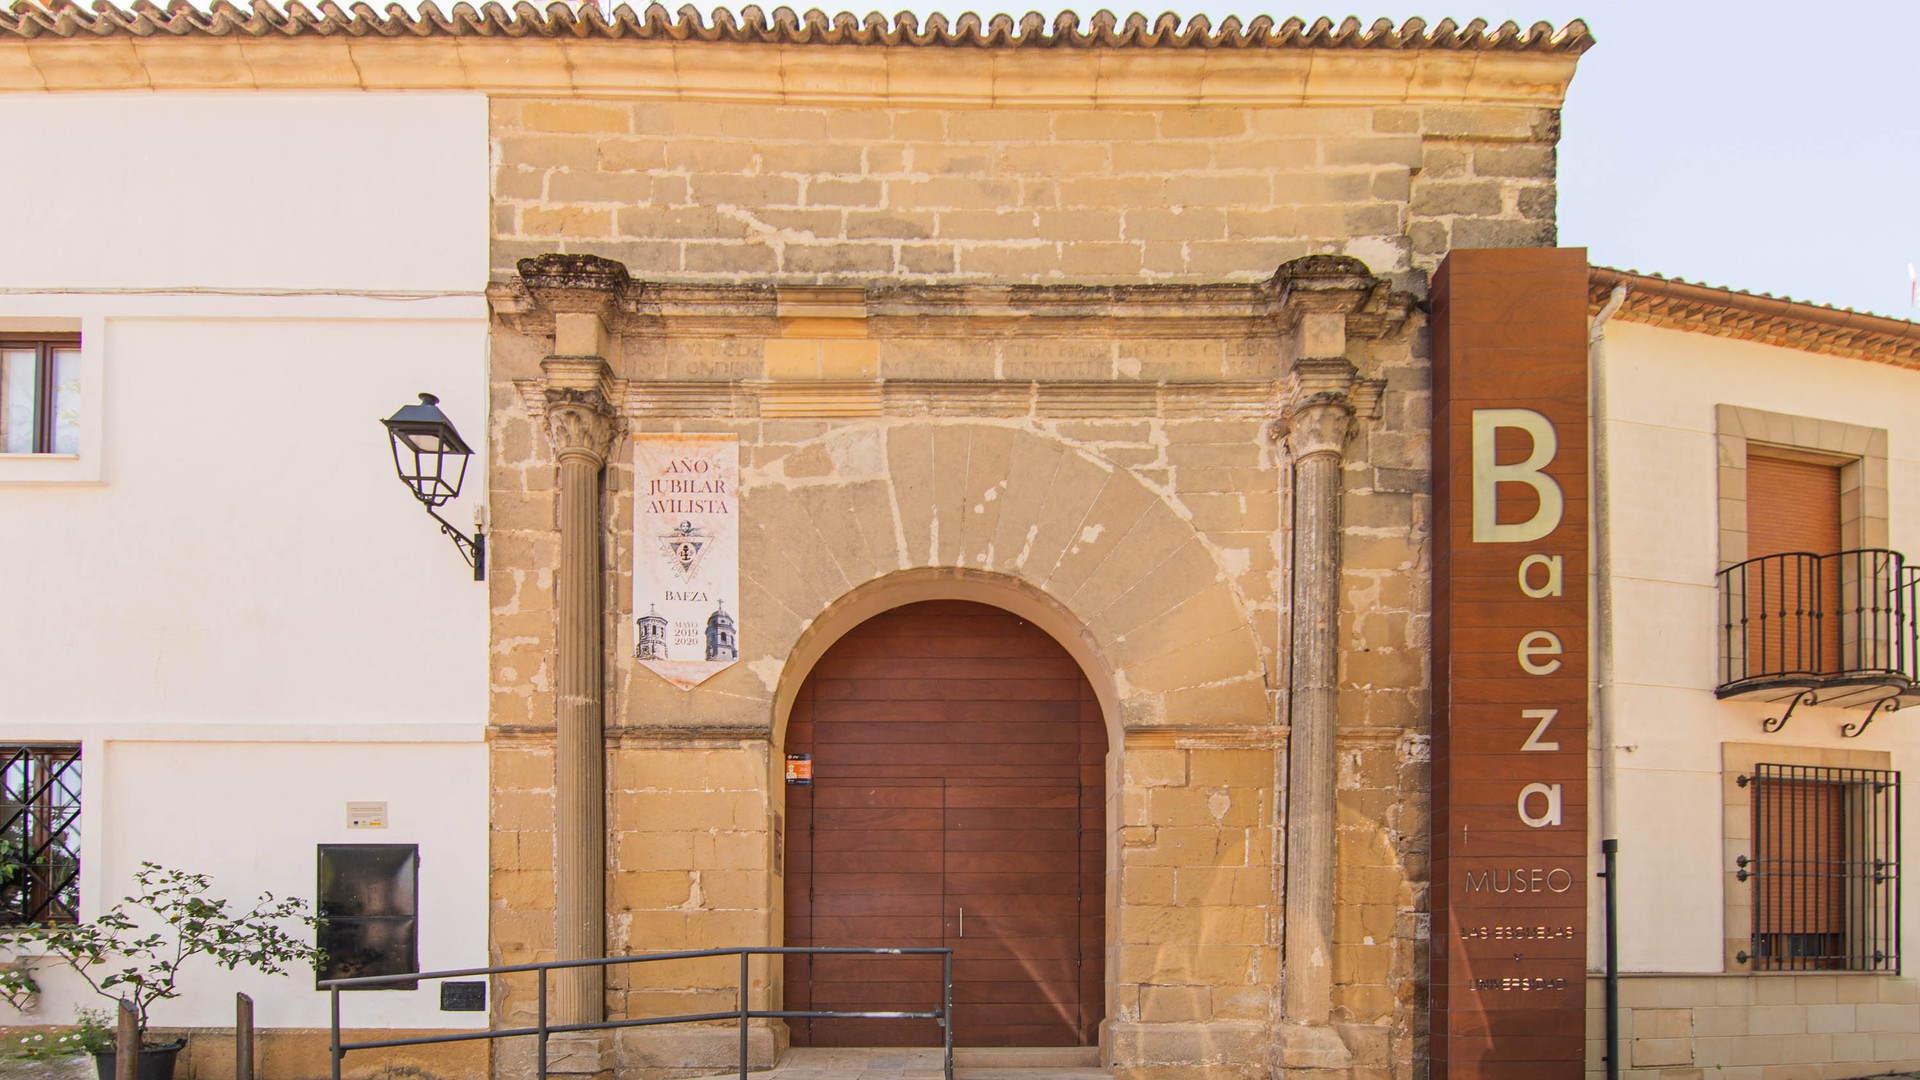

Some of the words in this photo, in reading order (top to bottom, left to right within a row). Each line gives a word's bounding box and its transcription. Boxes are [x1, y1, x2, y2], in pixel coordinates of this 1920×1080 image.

[666, 457, 709, 474] AÑO
[646, 479, 726, 496] JUBILAR
[646, 499, 729, 514] AVILISTA
[665, 590, 709, 602] BAEZA
[674, 621, 699, 629] MAYO
[1472, 408, 1564, 829] Baeza
[674, 629, 699, 637] 2019
[674, 637, 699, 646] 2020
[1465, 868, 1572, 893] MUSEO
[1461, 926, 1489, 940] LAS
[1495, 926, 1575, 940] ESCUELAS
[1469, 977, 1568, 992] UNIVERSIDAD
